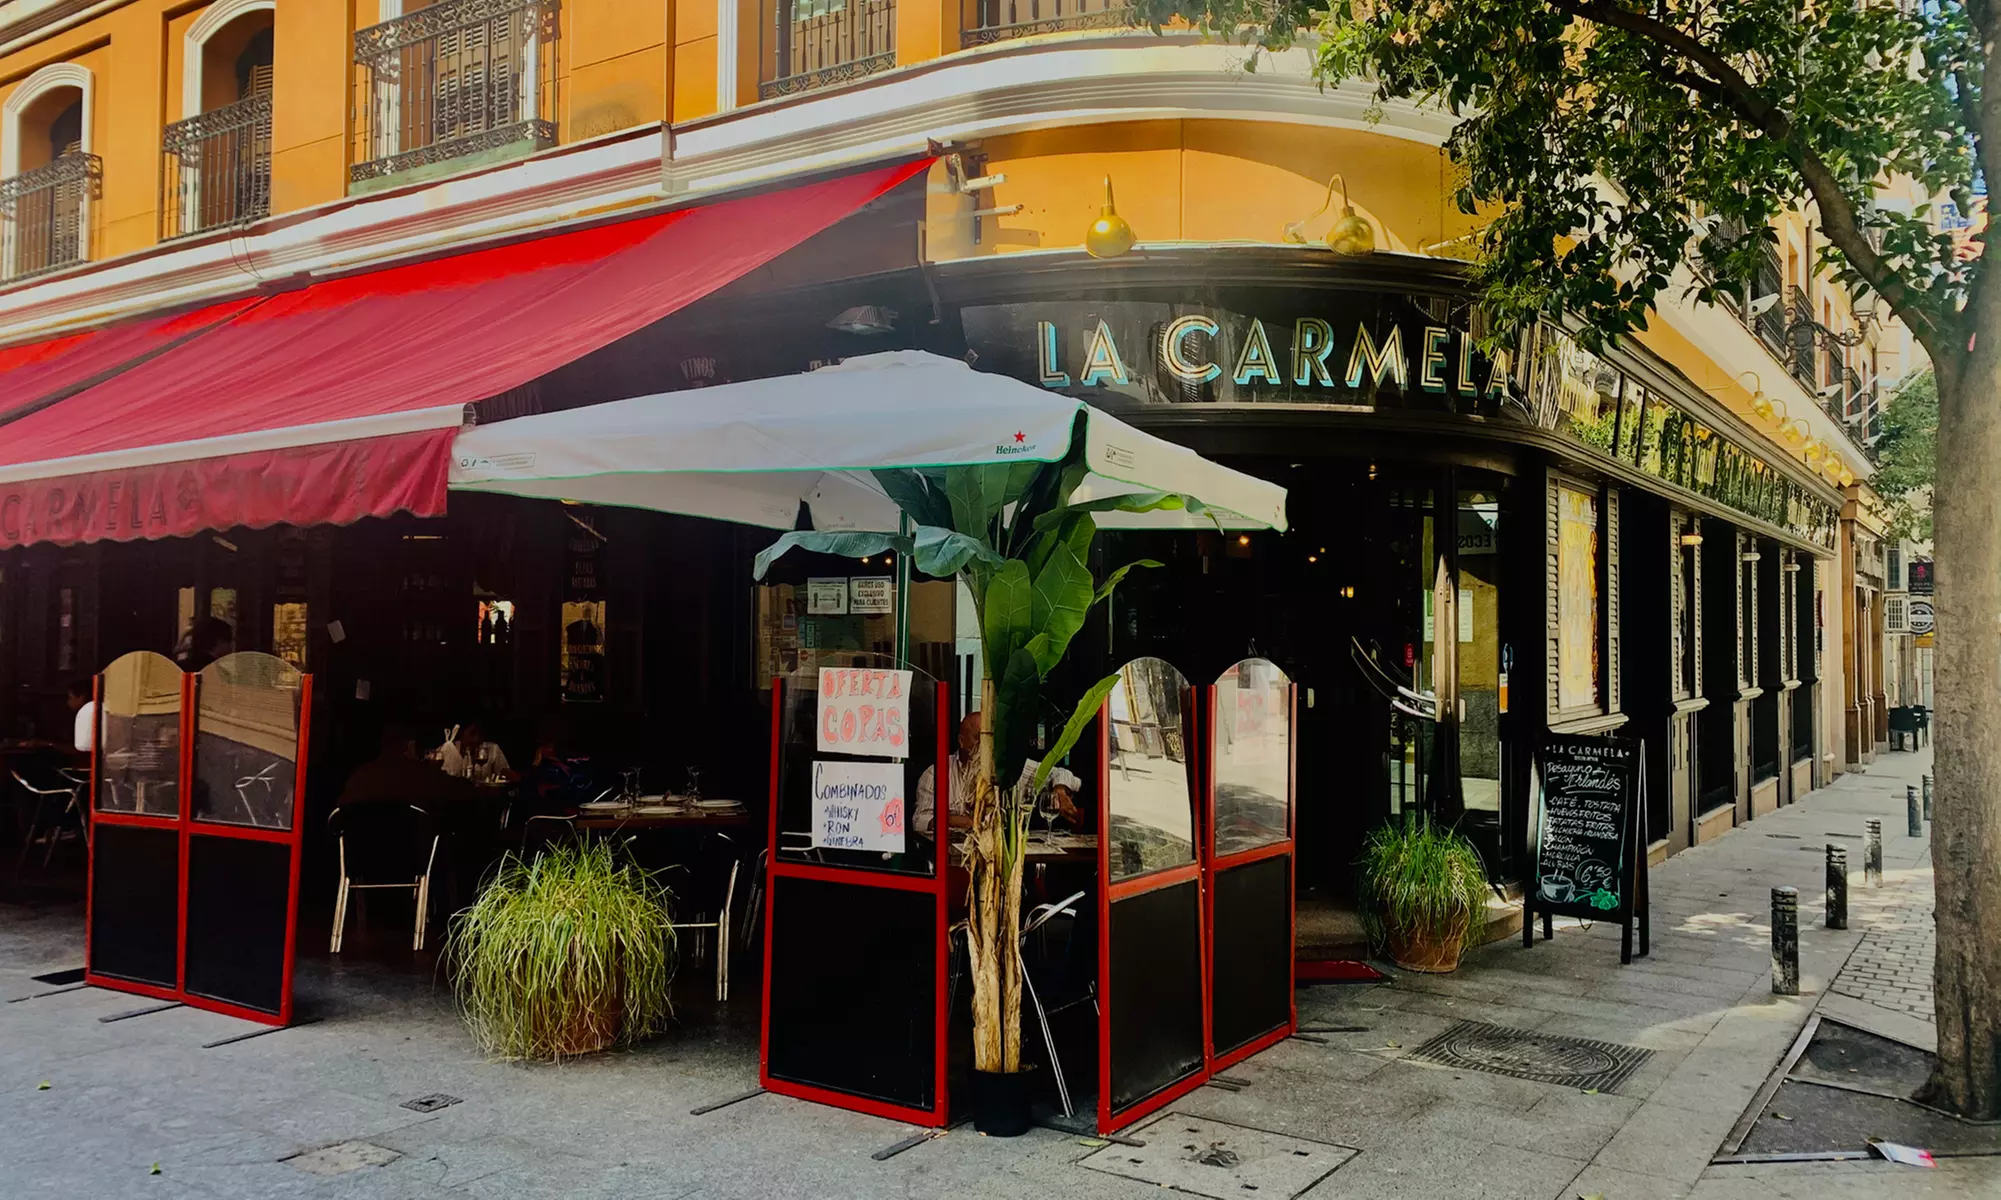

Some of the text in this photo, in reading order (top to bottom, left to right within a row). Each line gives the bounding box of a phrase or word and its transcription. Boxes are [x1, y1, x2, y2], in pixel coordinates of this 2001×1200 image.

[1037, 318, 1130, 388] LA
[1162, 314, 1509, 398] CARMELA
[680, 356, 717, 380] VINOS
[995, 444, 1036, 455] Heineken
[822, 669, 904, 700] OFERTA
[821, 703, 905, 747] COPAS
[1552, 744, 1624, 758] LA CARMELA
[1546, 761, 1593, 776] Desayuno
[815, 762, 887, 801] COMBINADOS
[1562, 769, 1621, 790] Irlandés
[1578, 809, 1612, 821] FRITOS
[827, 820, 850, 833] RON
